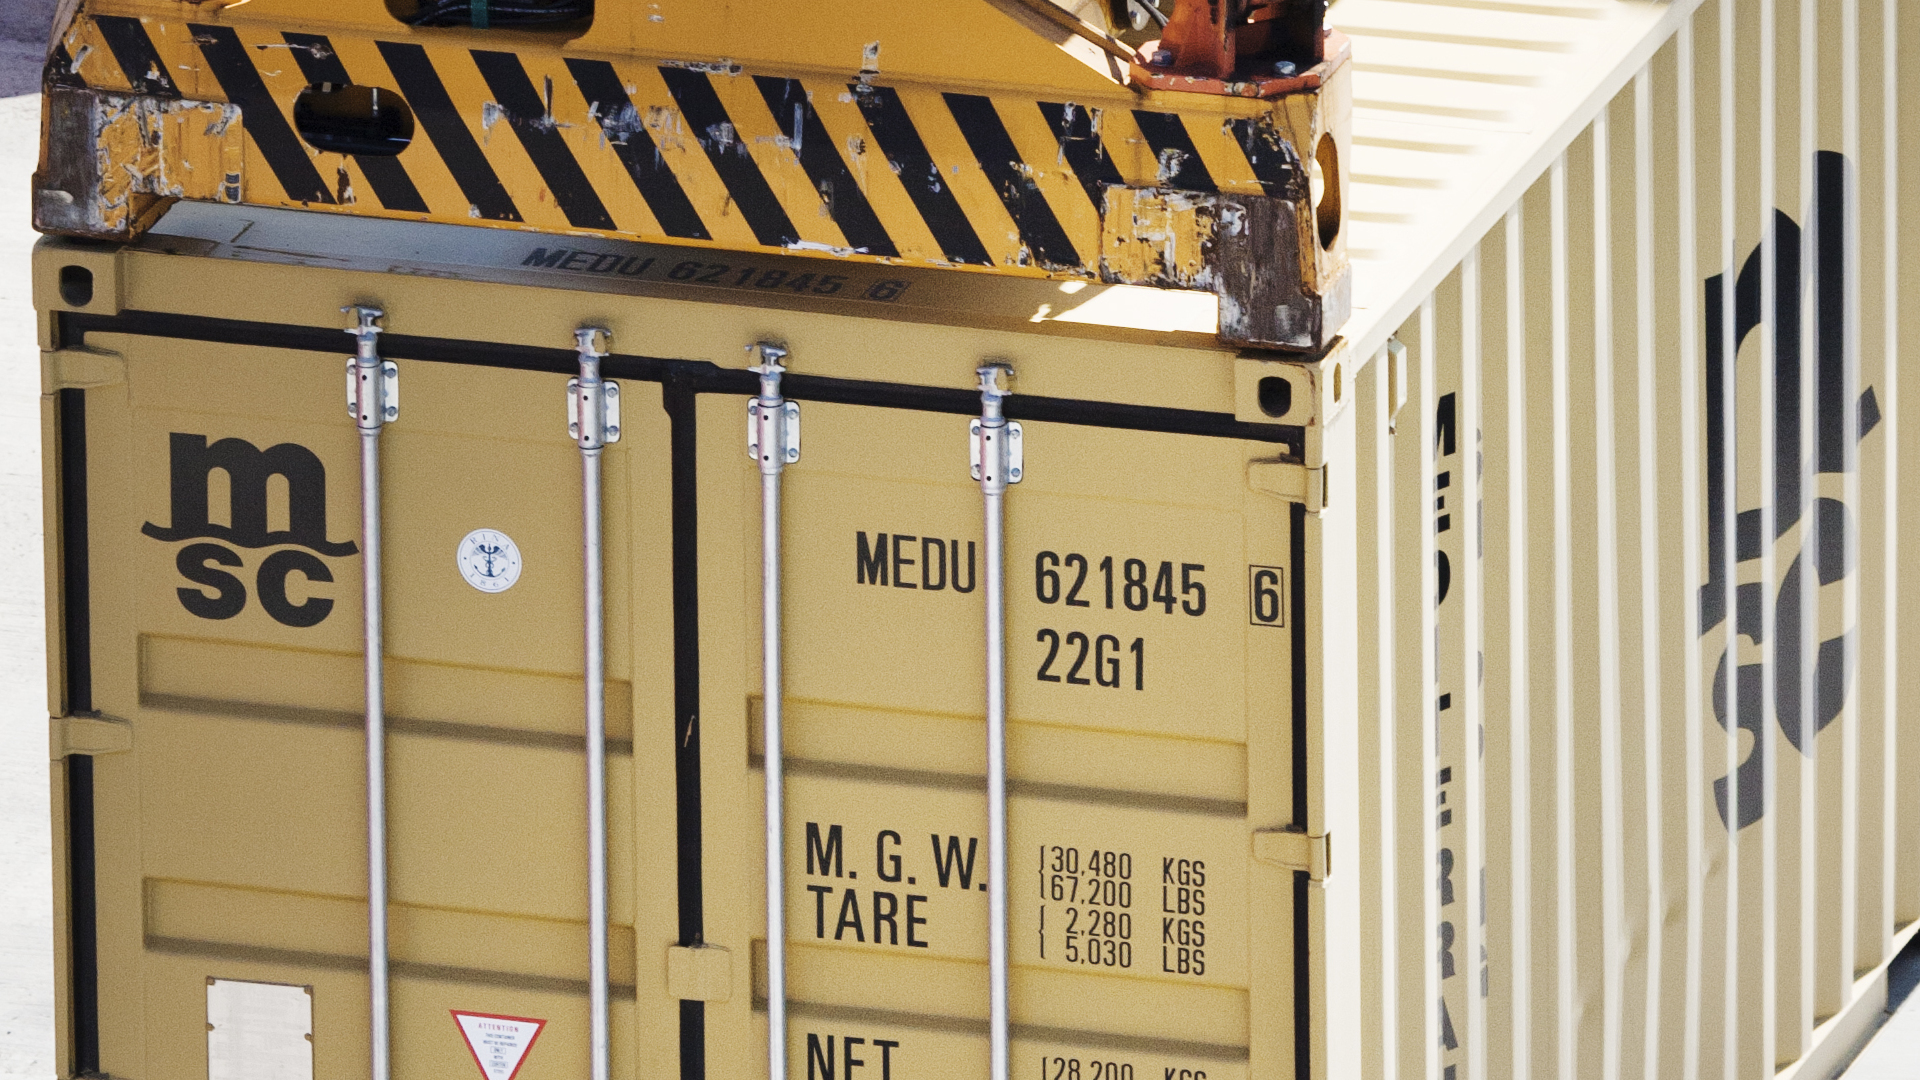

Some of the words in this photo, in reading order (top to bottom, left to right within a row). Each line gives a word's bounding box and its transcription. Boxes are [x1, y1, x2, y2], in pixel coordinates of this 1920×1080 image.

[520, 247, 656, 277] MEDU
[666, 260, 850, 296] 621845
[866, 280, 904, 301] 6
[856, 531, 977, 594] MEDU
[1034, 550, 1207, 618] 621845
[1253, 569, 1280, 624] 6
[1036, 627, 1145, 691] 22G1
[1050, 846, 1133, 880] 30,480
[1162, 857, 1206, 888] KGS
[806, 884, 929, 948] TARE
[1050, 874, 1133, 909] 67,200
[1162, 885, 1206, 916] LBS
[1065, 907, 1132, 940] 2,280
[1162, 917, 1206, 948] KGS
[1065, 935, 1132, 968] 5,030
[1162, 945, 1206, 976] LBS
[478, 1022, 520, 1033] ATTENTION
[1053, 1057, 1134, 1080] 28200
